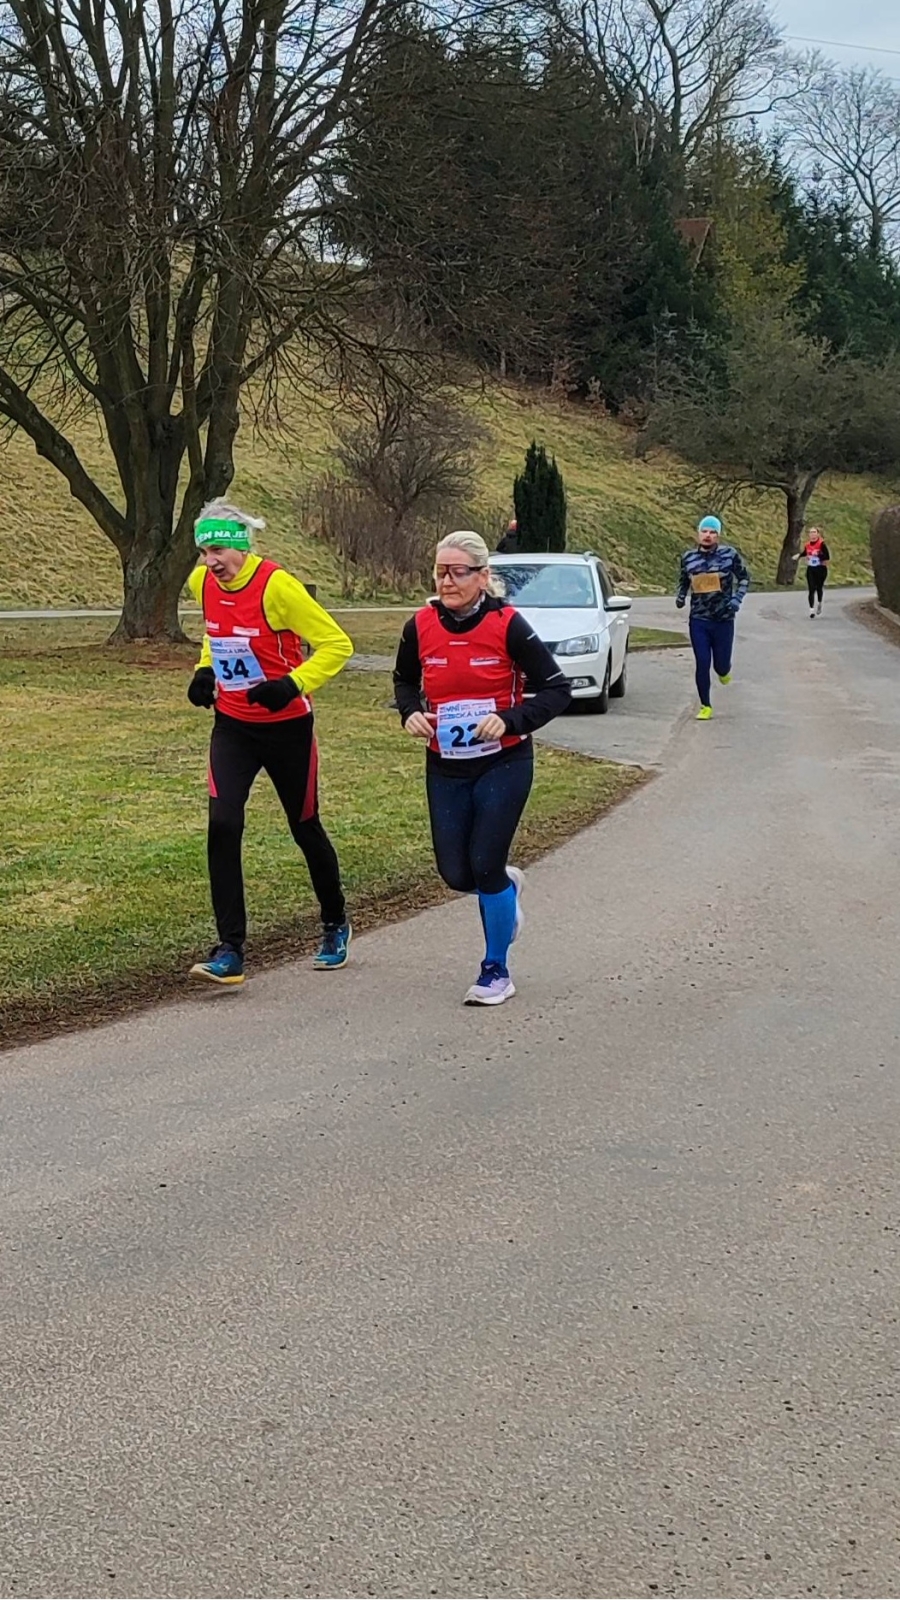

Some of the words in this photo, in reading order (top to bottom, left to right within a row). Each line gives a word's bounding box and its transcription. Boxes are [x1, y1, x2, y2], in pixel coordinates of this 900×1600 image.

[214, 530, 231, 538] NA
[218, 658, 249, 681] 34
[450, 724, 485, 748] 22
